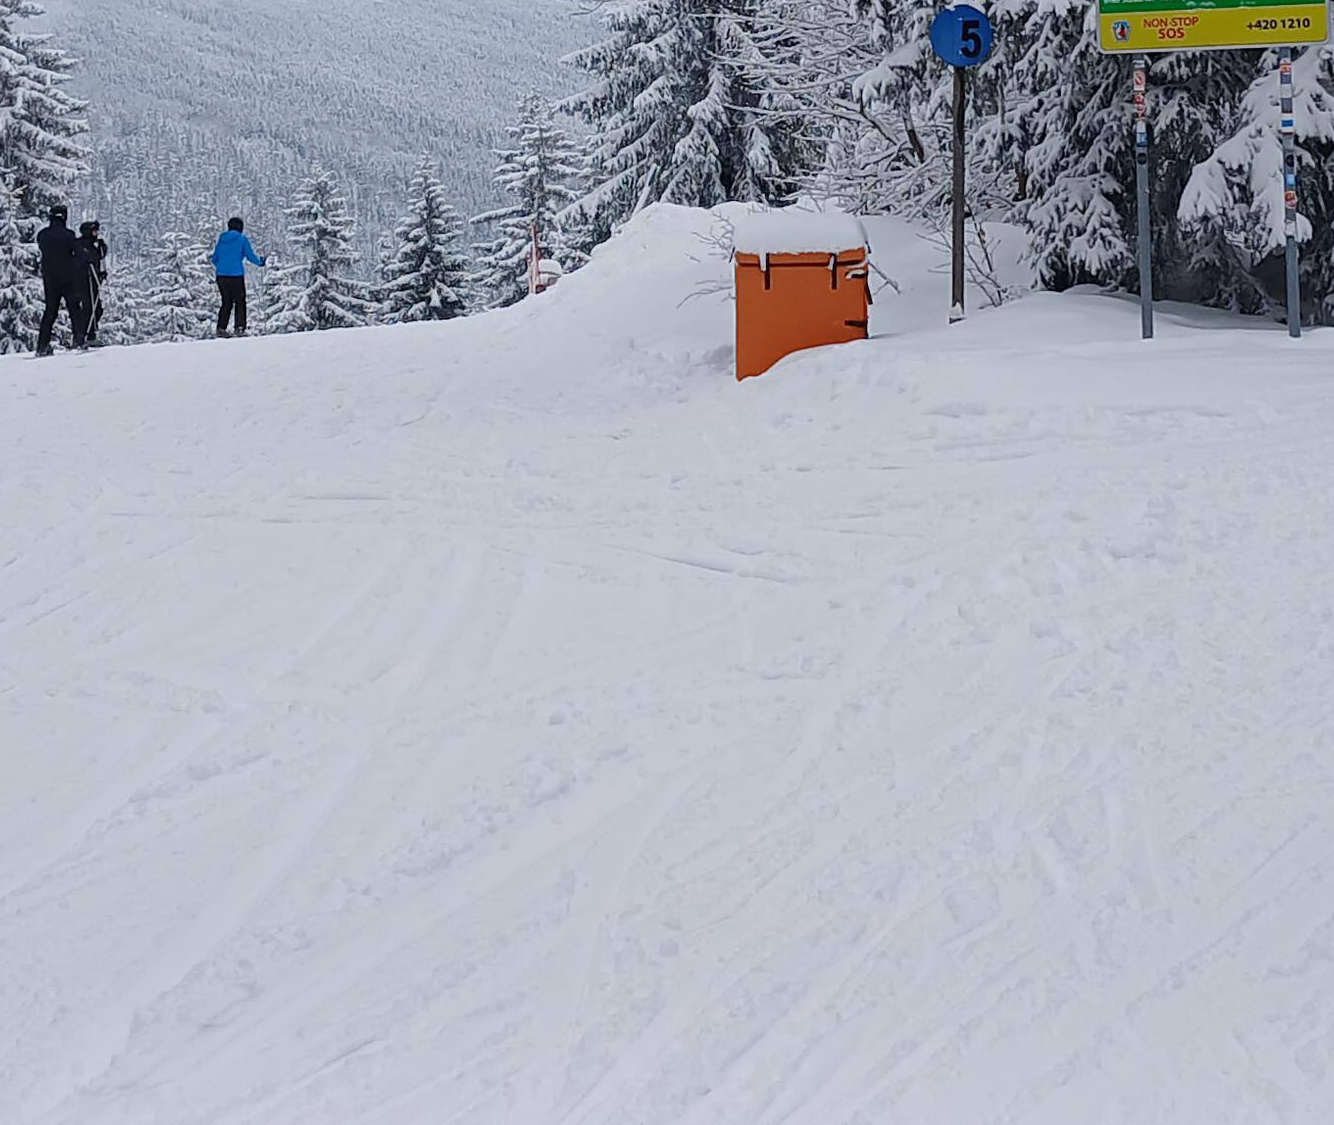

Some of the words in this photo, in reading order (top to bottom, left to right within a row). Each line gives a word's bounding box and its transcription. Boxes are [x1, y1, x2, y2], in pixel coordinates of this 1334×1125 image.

[1247, 19, 1278, 31] +420
[1280, 17, 1311, 29] 1210
[961, 20, 982, 59] 5
[1158, 28, 1185, 40] SOS
